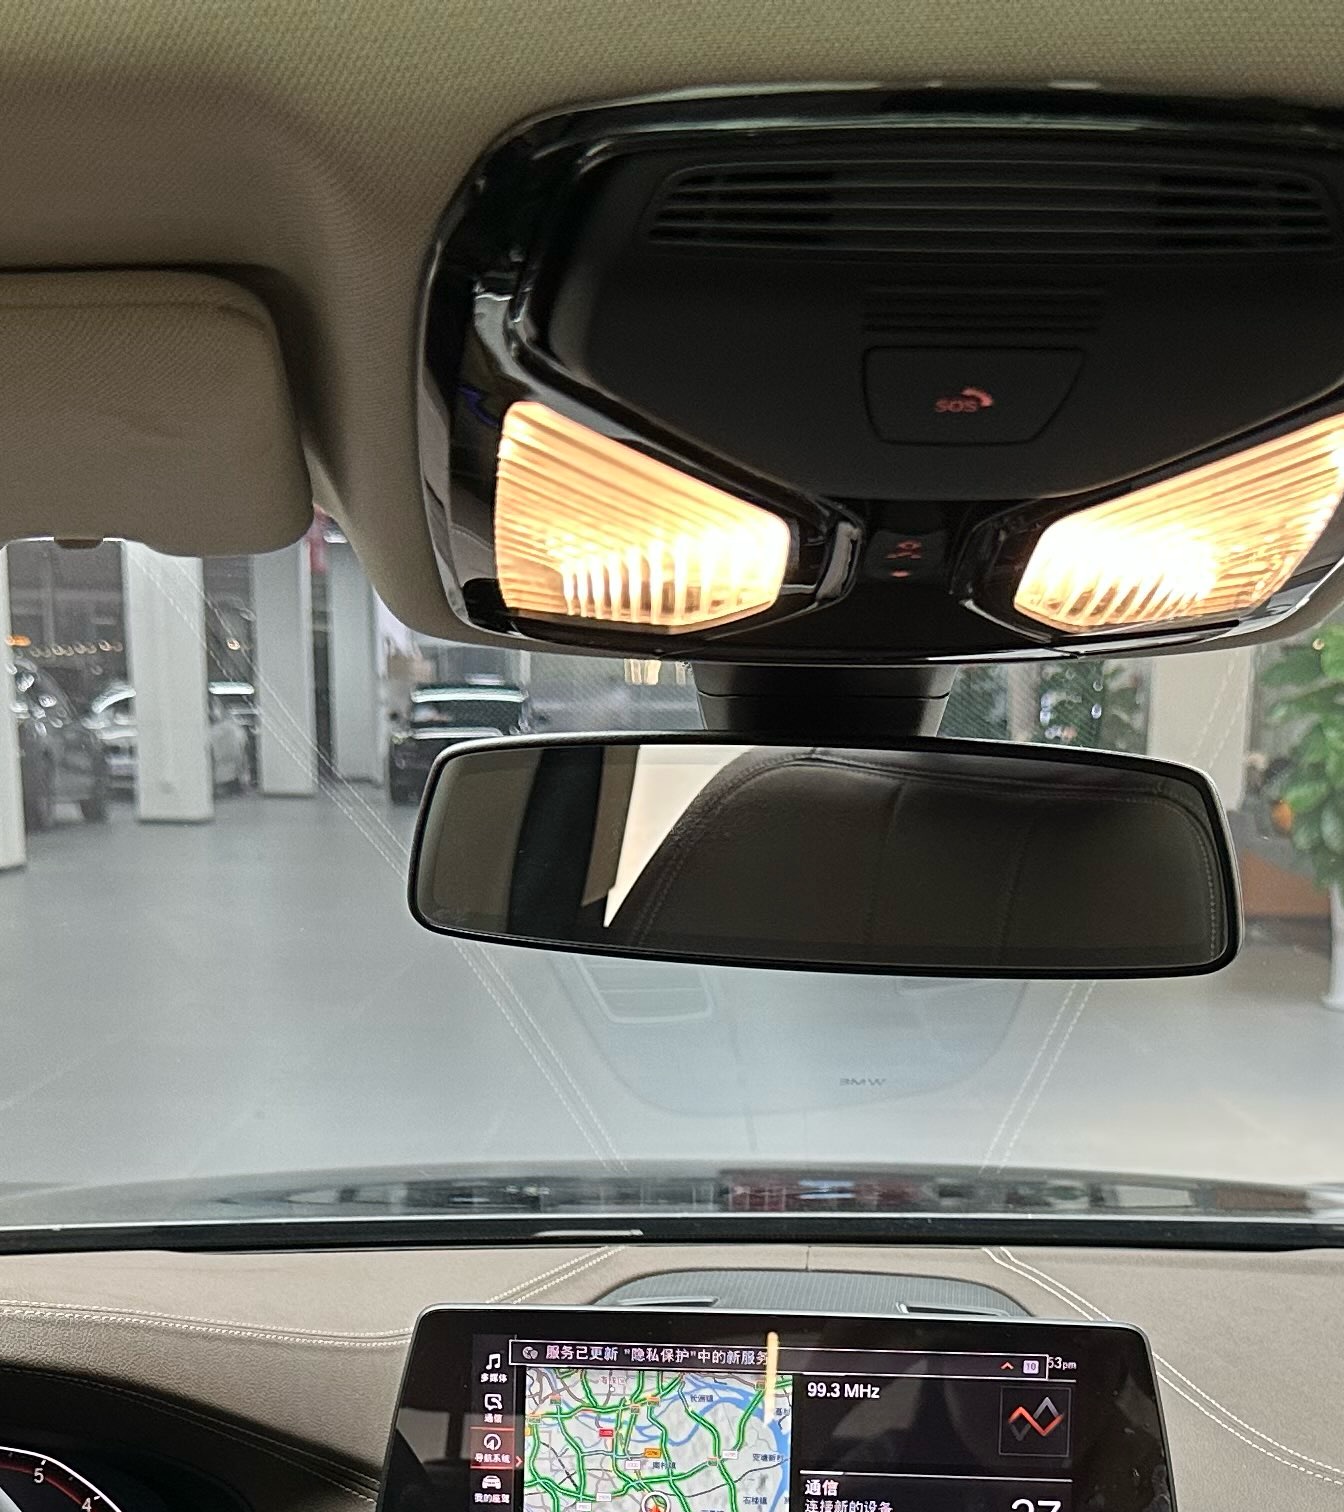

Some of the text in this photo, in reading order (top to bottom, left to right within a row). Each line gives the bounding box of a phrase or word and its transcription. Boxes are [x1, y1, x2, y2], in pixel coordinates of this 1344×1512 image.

[935, 399, 977, 413] SOS
[545, 1344, 619, 1362] 服务已更新
[807, 1382, 880, 1399] 99.3 MHz
[33, 1468, 45, 1484] 5
[805, 1479, 838, 1497] 通信
[81, 1498, 93, 1512] 4
